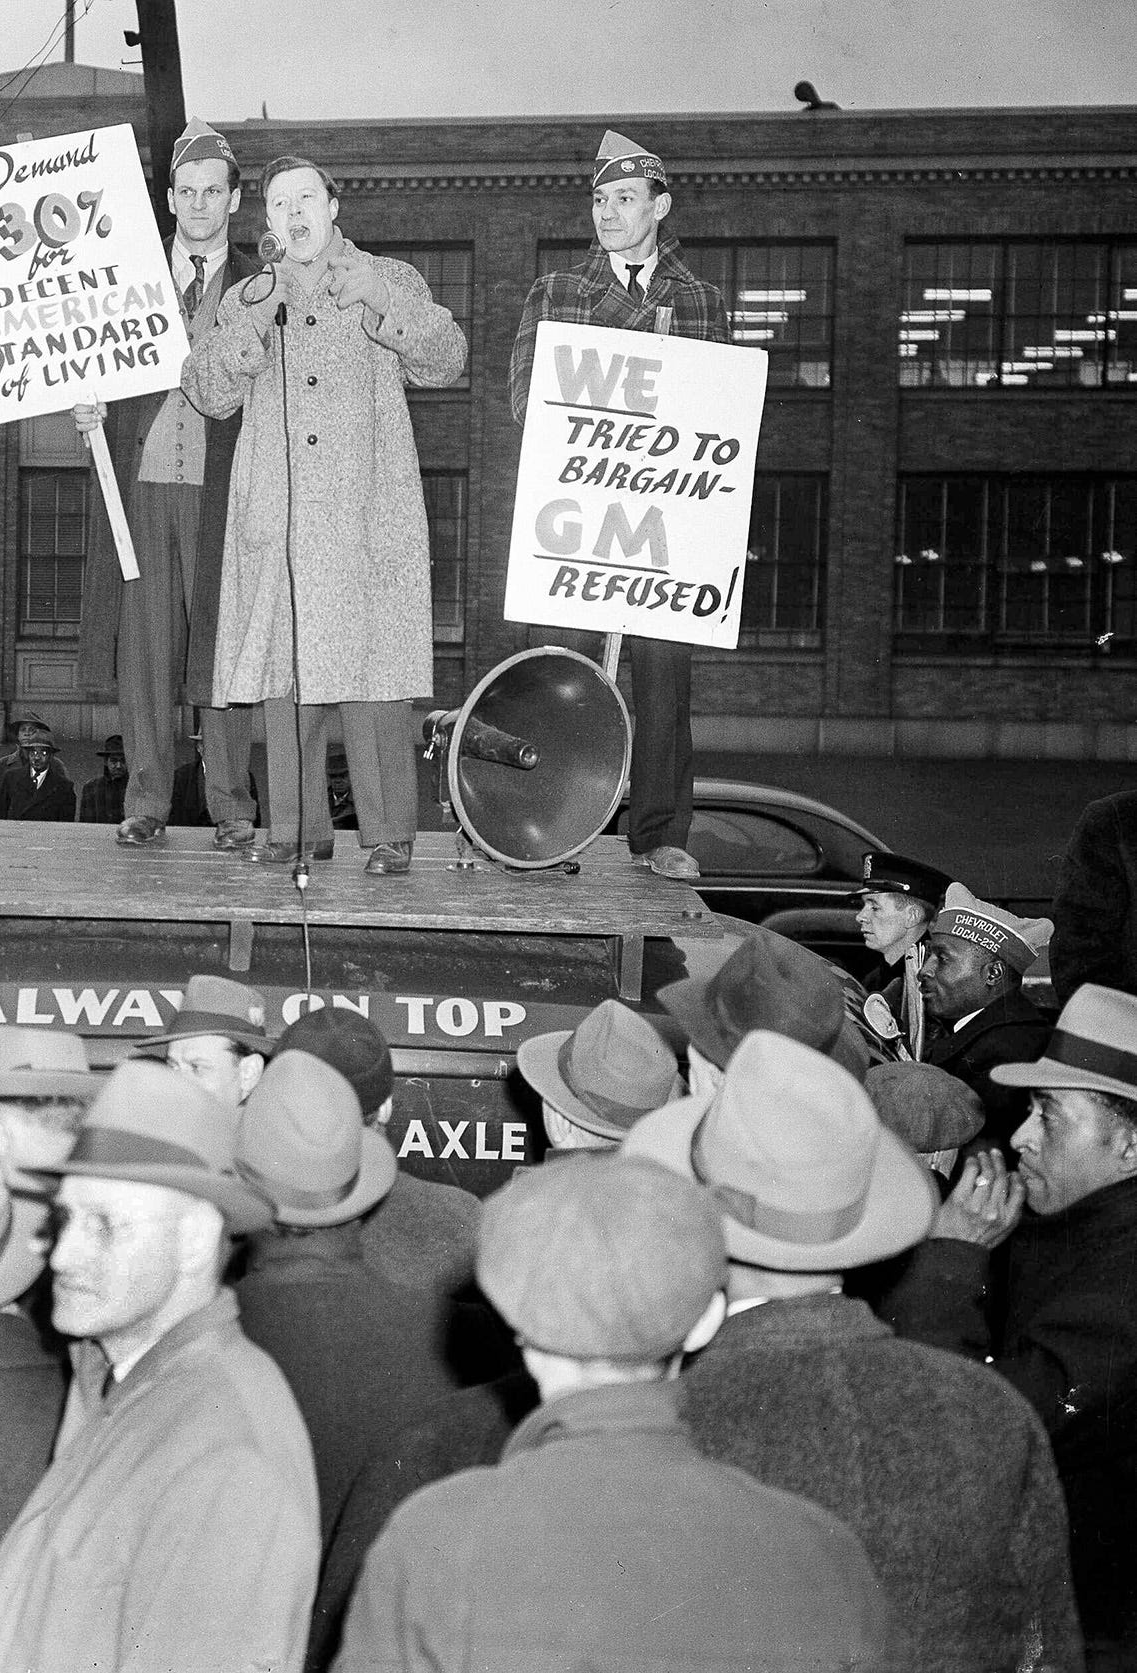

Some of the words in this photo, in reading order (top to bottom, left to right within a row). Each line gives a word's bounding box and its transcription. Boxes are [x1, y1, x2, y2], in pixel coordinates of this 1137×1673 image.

[27, 241, 77, 281] for
[0, 313, 169, 366] TANDARD
[1, 364, 32, 402] of
[42, 342, 161, 387] LIVING
[553, 344, 664, 413] WE
[567, 415, 680, 457] TRIED
[693, 432, 741, 466] TO
[558, 455, 737, 501] BARGAIN-
[534, 498, 670, 568] GM
[548, 566, 740, 624] REFUSED!
[951, 924, 1002, 953] LOCAL-235
[955, 914, 1009, 943] CHEVROLET
[395, 996, 527, 1037] TOP
[396, 1119, 528, 1161] AXLE
